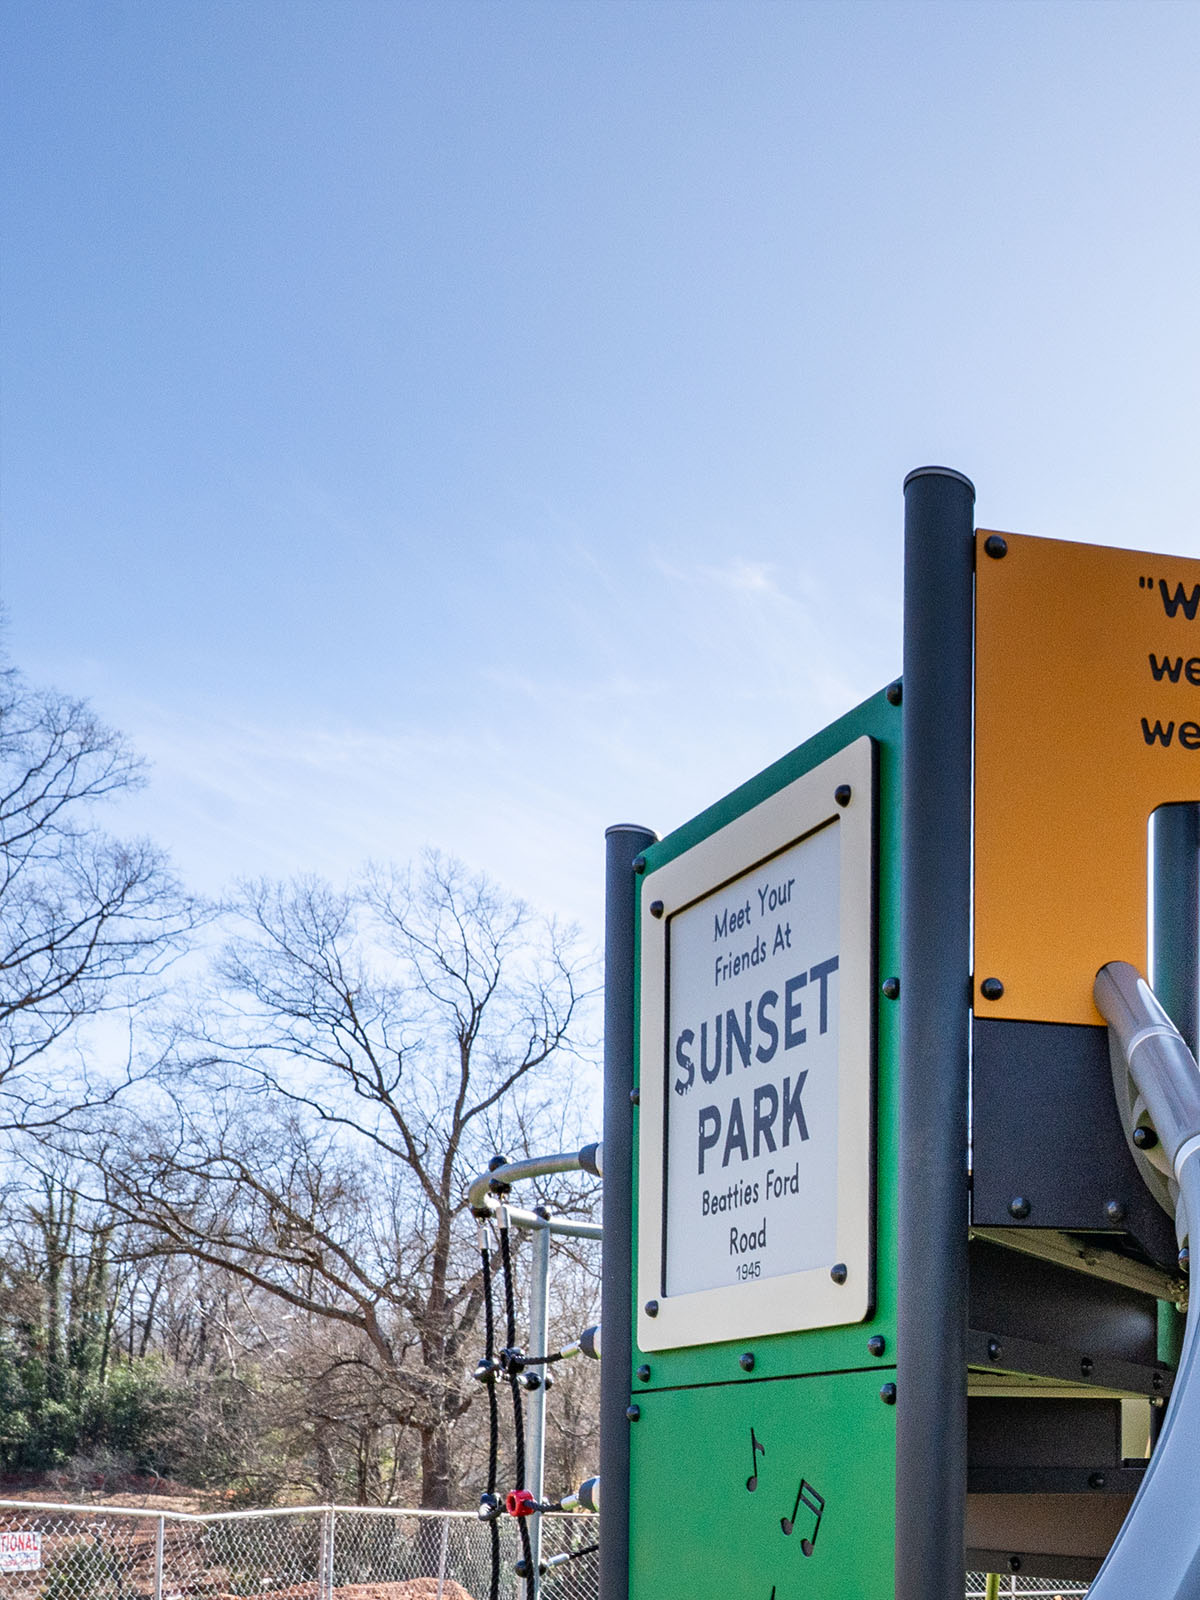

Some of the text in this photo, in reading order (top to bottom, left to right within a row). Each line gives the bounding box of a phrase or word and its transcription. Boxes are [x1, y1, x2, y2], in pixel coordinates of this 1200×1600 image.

[713, 877, 796, 943] Meet Your
[714, 923, 792, 987] Friends At
[674, 954, 840, 1097] SUNSET
[698, 1069, 810, 1175] PARK
[702, 1163, 800, 1217] Beatties Ford
[729, 1217, 767, 1256] Road
[735, 1260, 762, 1281] 1945
